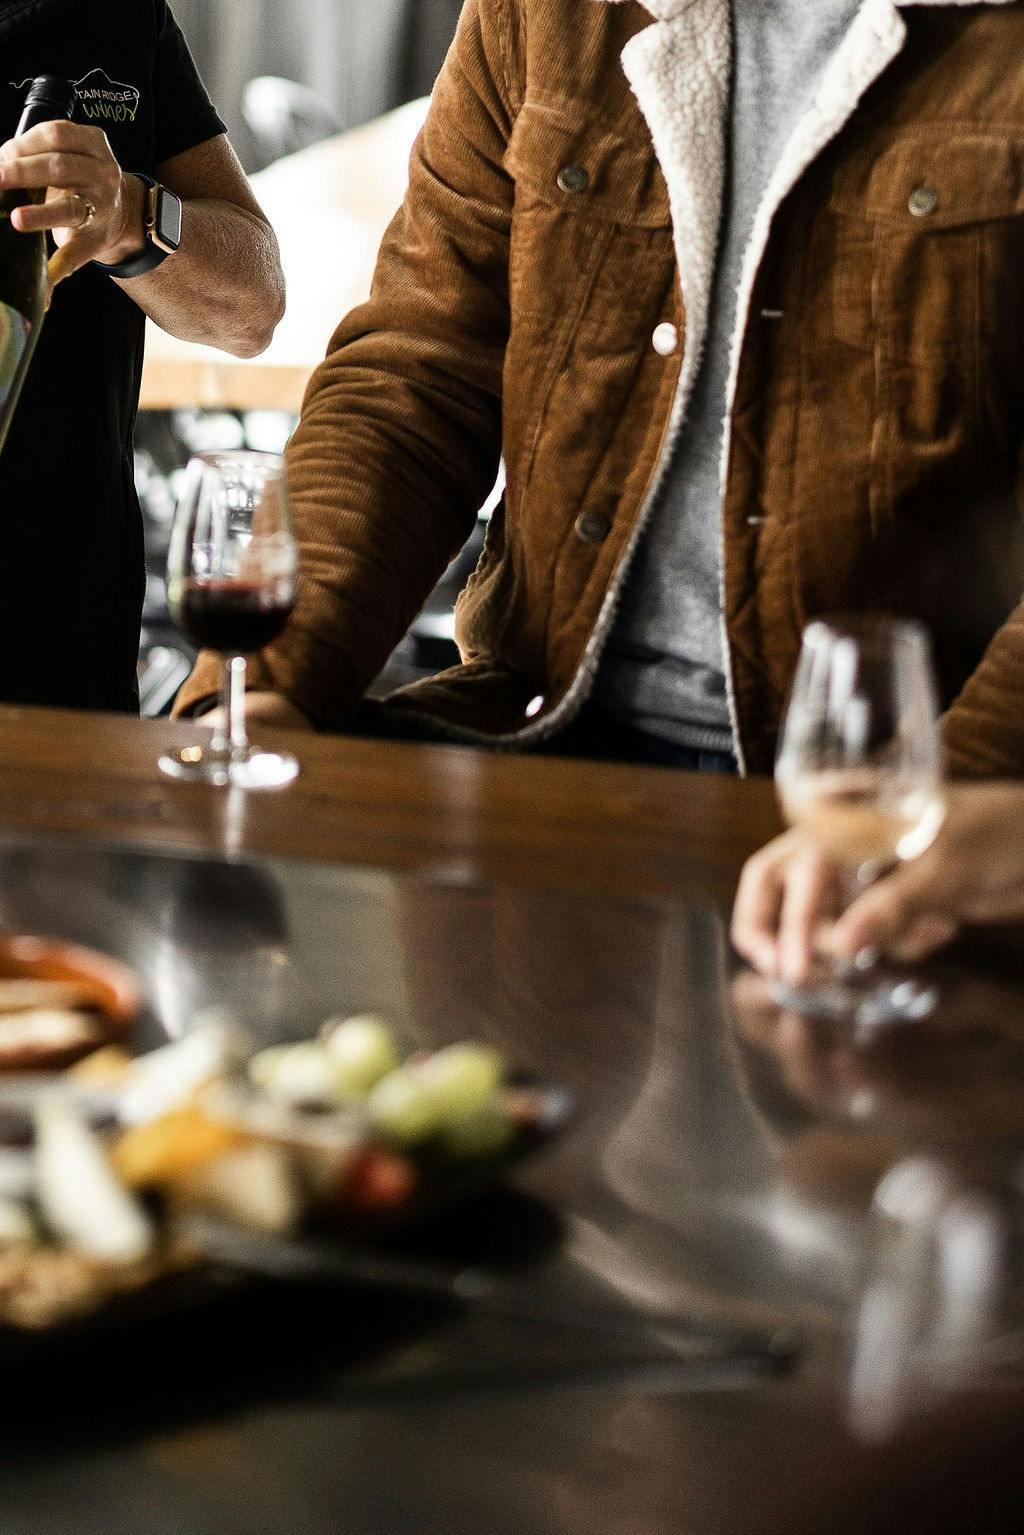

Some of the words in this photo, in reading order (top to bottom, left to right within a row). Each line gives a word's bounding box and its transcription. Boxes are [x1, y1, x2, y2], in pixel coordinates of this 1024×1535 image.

[77, 89, 101, 99] TAIN
[102, 90, 133, 101] RIDGE
[83, 101, 134, 121] wines
